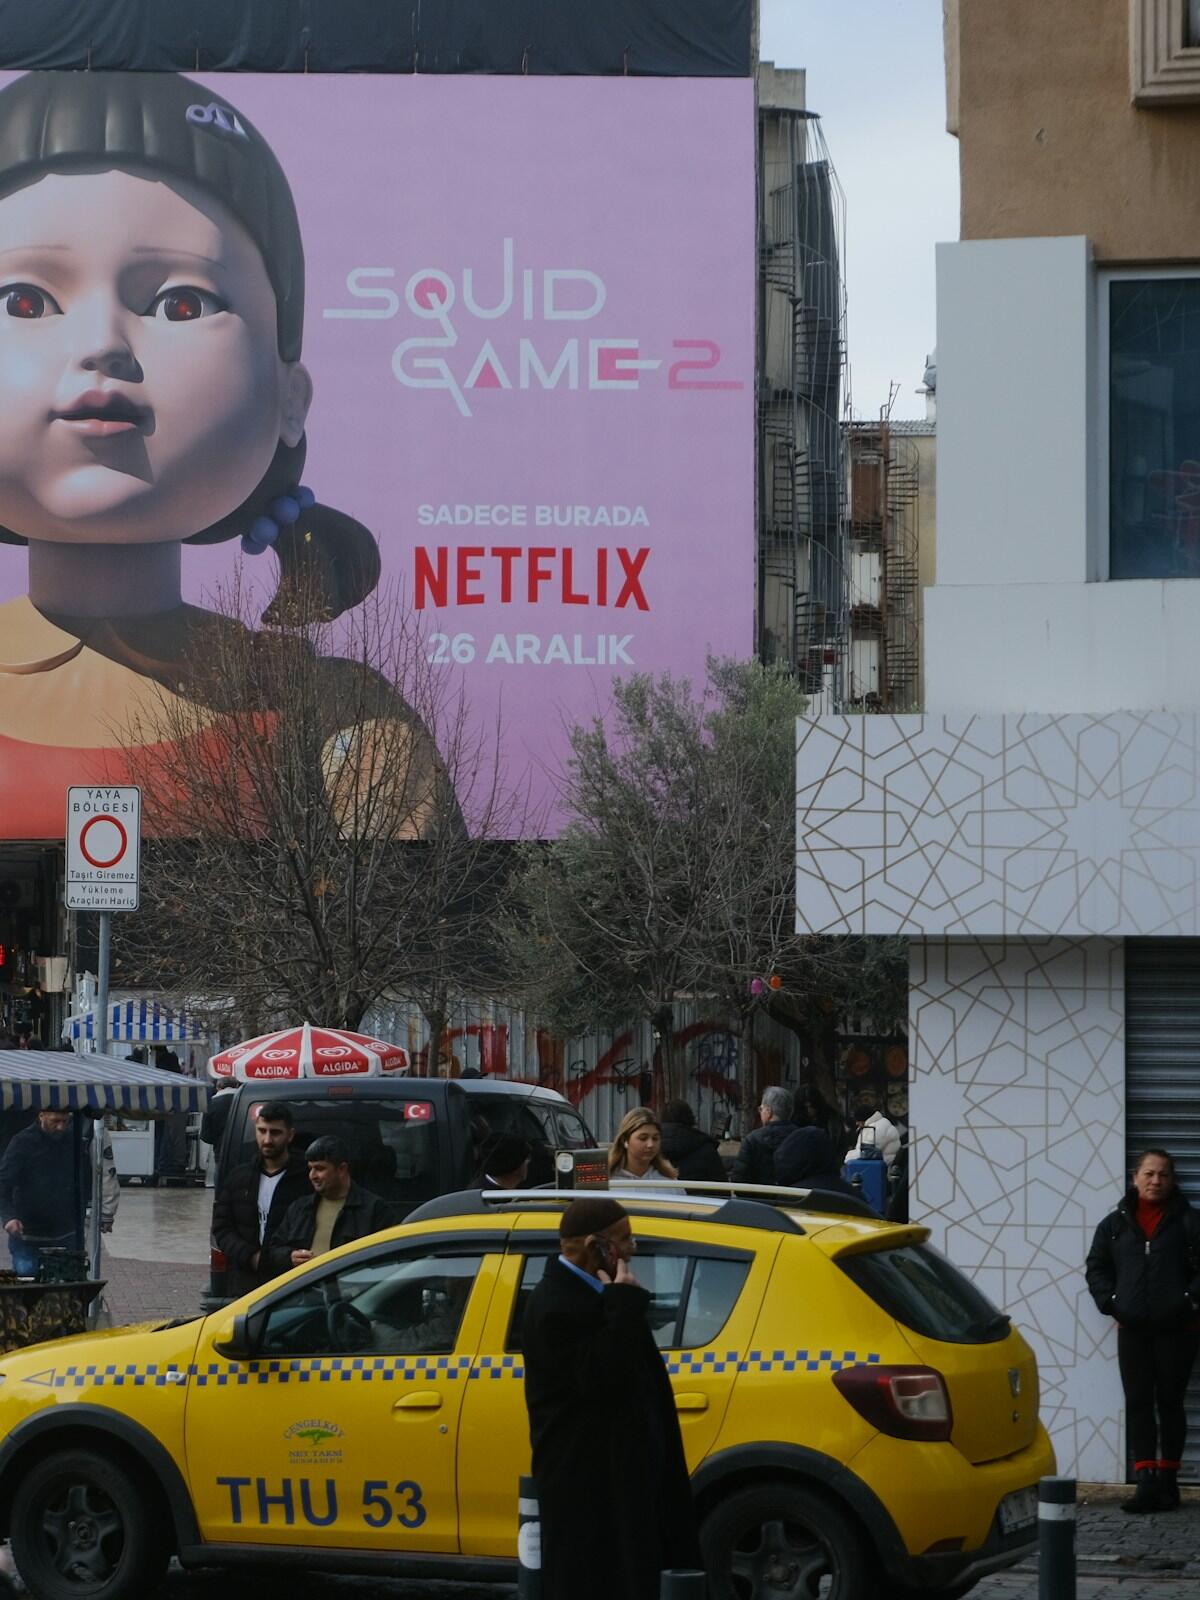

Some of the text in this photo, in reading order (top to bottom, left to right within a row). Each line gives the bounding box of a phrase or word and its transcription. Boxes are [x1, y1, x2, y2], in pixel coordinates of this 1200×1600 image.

[322, 237, 607, 325] SQUID
[391, 337, 744, 417] GAME 2
[417, 504, 650, 527] SADECE BURADA
[415, 546, 651, 612] NETFLIX
[427, 633, 636, 665] 26 ARALIK
[87, 790, 121, 799] YAYA
[73, 800, 134, 813] BÖLGESİ
[70, 870, 135, 880] Taşıt Giremez
[81, 885, 124, 894] Yükleme
[69, 896, 135, 907] Araçları Hariç
[216, 1477, 427, 1529] THU 53
